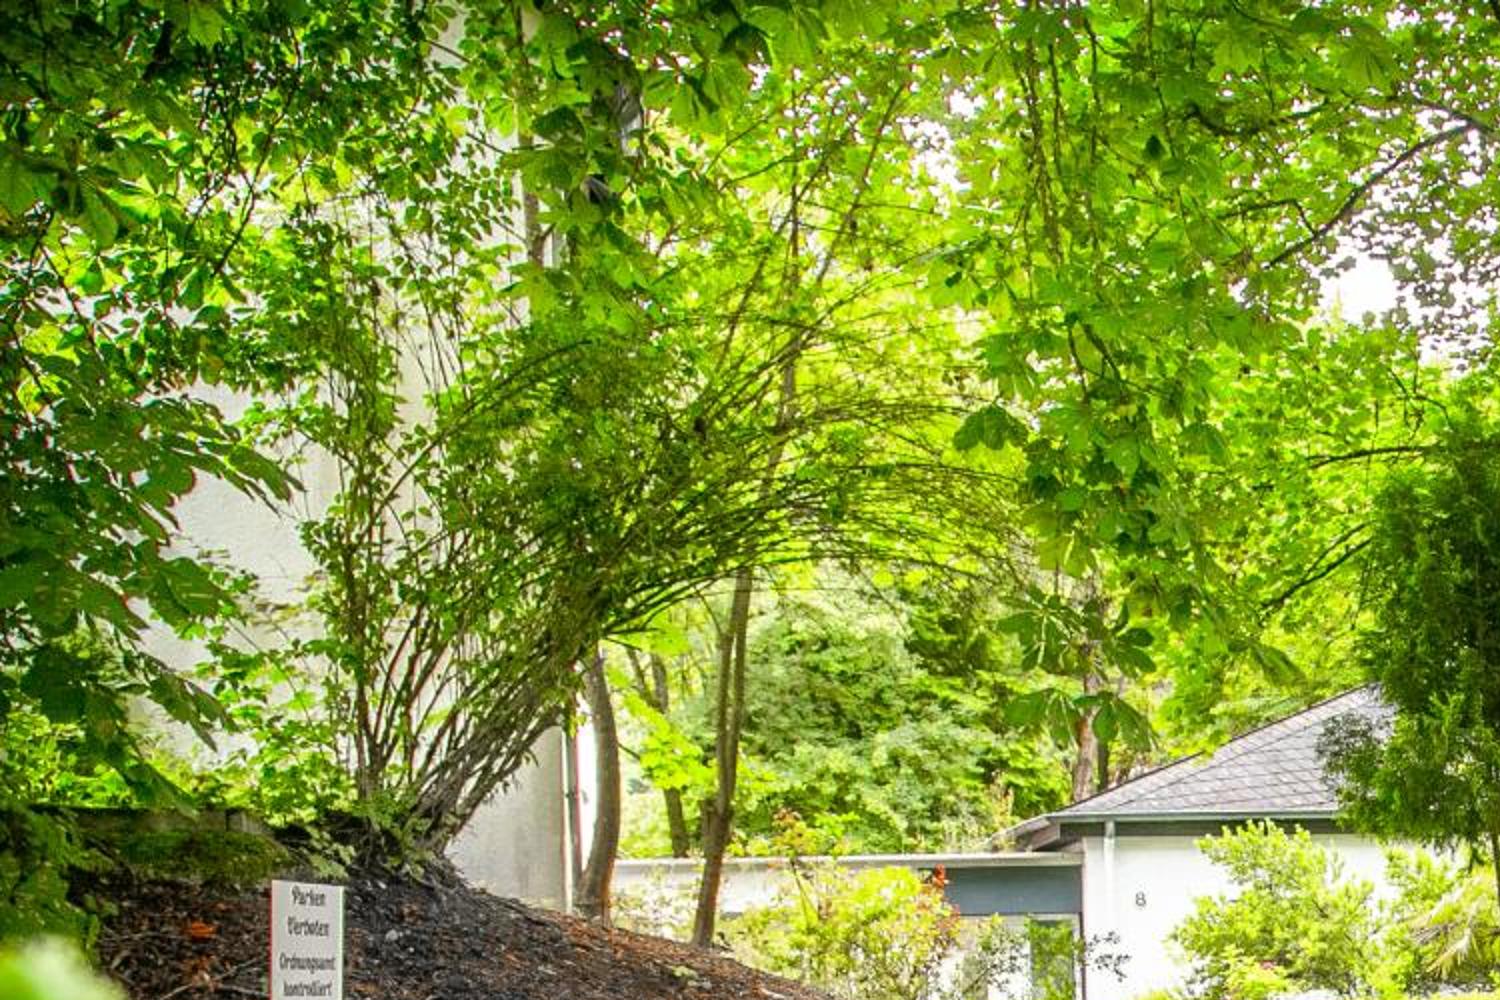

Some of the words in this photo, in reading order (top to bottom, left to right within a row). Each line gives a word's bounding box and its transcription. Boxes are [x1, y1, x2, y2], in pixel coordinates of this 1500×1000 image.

[292, 885, 326, 906] Parken
[1136, 892, 1147, 907] 8
[288, 916, 329, 937] Verboten
[280, 953, 336, 974] Ordnungsamt
